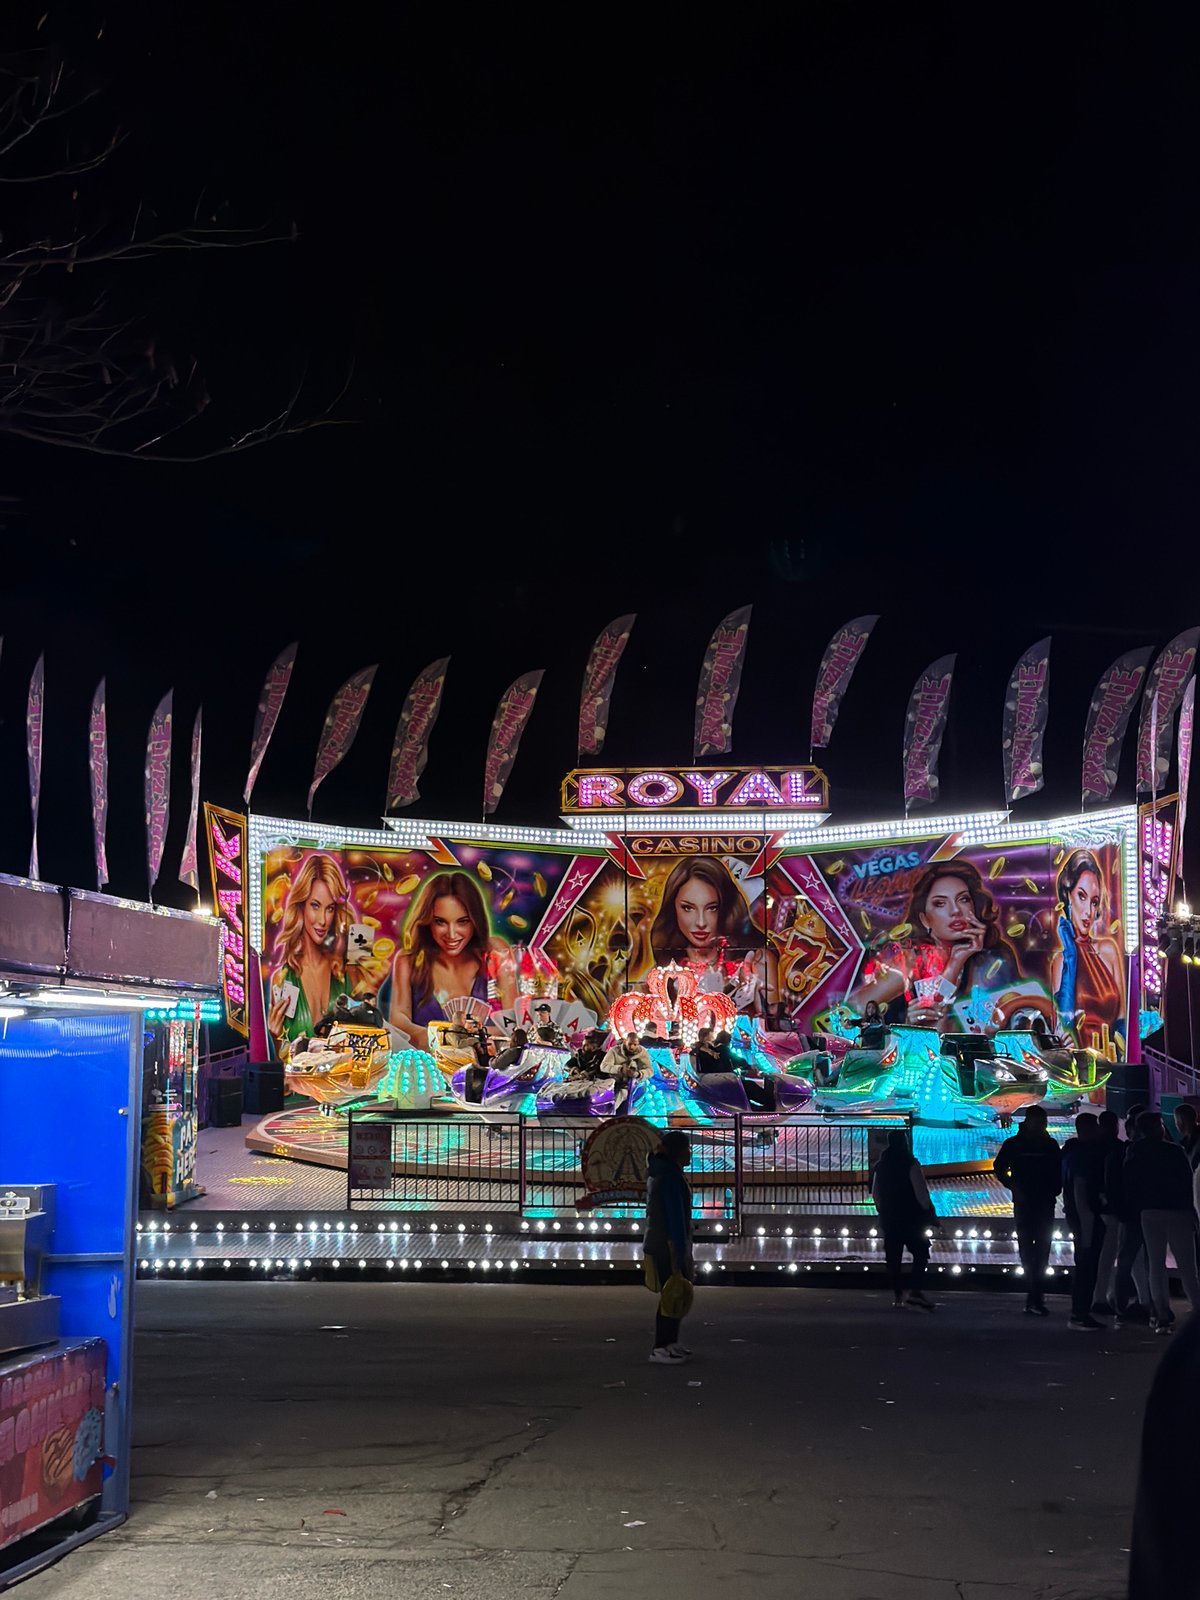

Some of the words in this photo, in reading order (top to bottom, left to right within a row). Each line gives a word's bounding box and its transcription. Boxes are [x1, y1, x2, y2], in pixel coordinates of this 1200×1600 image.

[578, 770, 823, 807] ROYAL
[631, 836, 761, 854] CASINO
[852, 851, 922, 879] VEGAS
[212, 823, 244, 1004] BREAK
[503, 1015, 516, 1028] A
[521, 1009, 534, 1026] A
[567, 1016, 579, 1032] A
